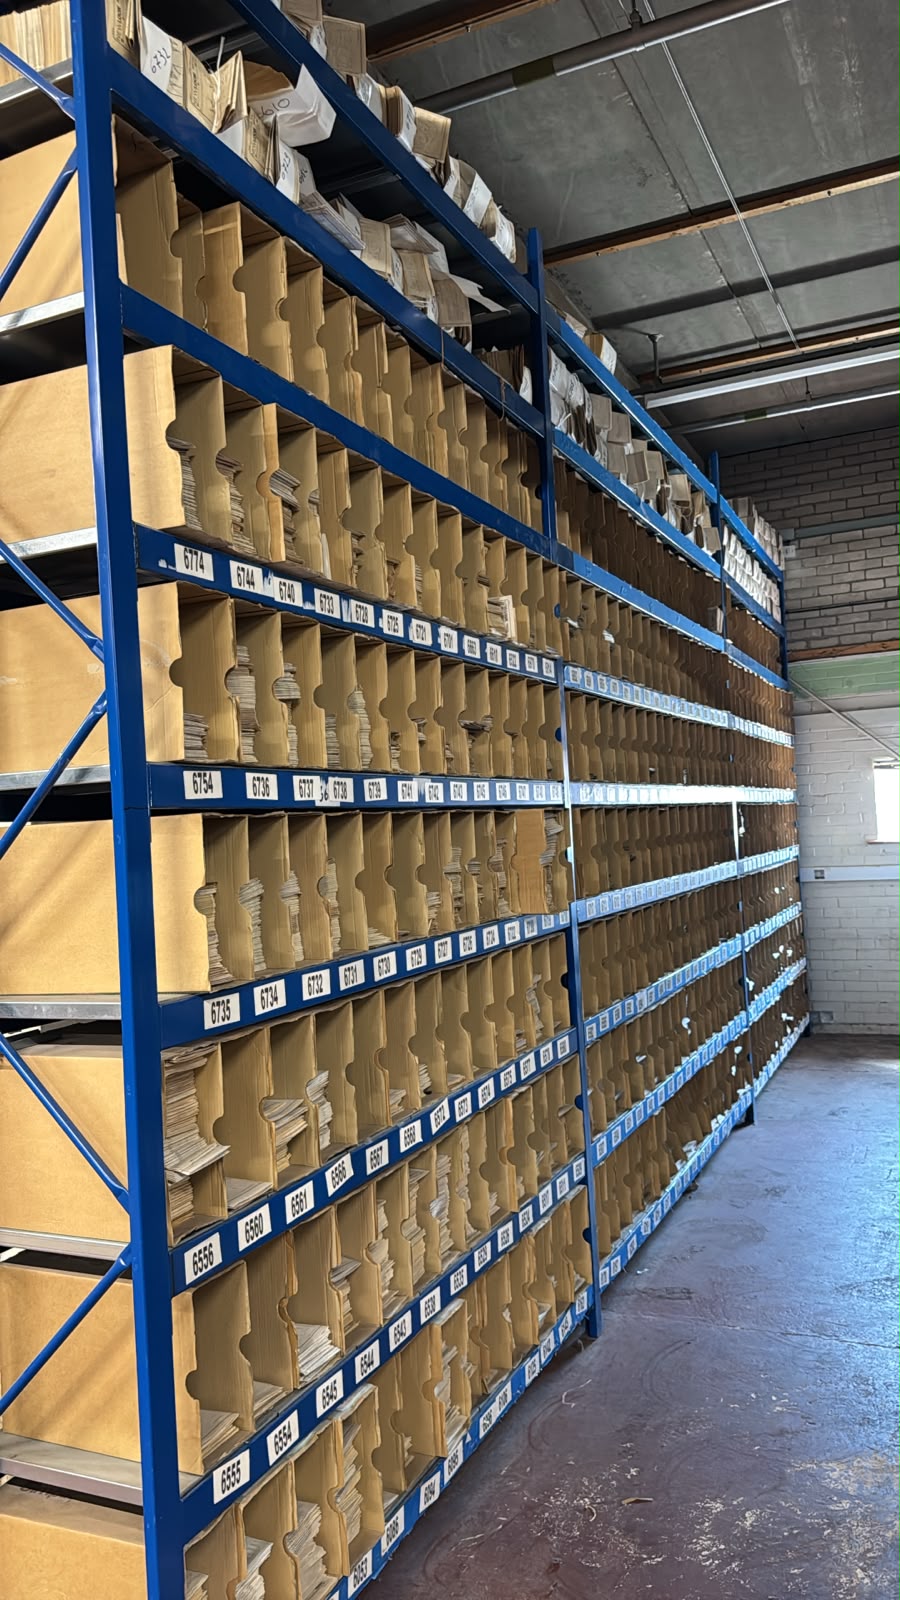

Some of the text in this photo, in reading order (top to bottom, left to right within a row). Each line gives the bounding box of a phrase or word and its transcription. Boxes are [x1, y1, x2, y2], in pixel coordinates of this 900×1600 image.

[183, 547, 204, 573] 6774
[236, 566, 255, 590] 6744
[279, 582, 296, 604] 6740
[320, 593, 334, 614] 6733
[387, 614, 399, 633] 6725
[416, 624, 426, 641] 6721
[192, 772, 213, 794] 6754
[252, 776, 270, 797] 6736
[299, 779, 314, 798] 6737
[333, 781, 347, 800] 6738
[368, 781, 381, 799] 6739
[402, 783, 412, 799] 6741
[428, 784, 439, 800] 6742
[411, 948, 422, 967] 6729
[438, 941, 448, 959] 6727
[344, 965, 358, 986] 6731
[378, 957, 390, 977] 6730
[308, 974, 323, 996] 6732
[261, 984, 278, 1010] 6734
[211, 999, 231, 1024] 6735
[434, 1103, 445, 1128] 6572
[404, 1125, 415, 1148] 6568
[370, 1146, 383, 1170] 6567
[331, 1160, 346, 1189] 6566
[291, 1189, 307, 1217] 6561
[245, 1213, 263, 1243] 6560
[193, 1242, 213, 1276] 6556
[394, 1319, 406, 1345] 6543
[360, 1350, 374, 1376] 6544
[322, 1379, 338, 1409] 6545
[274, 1421, 292, 1455] 6554
[221, 1459, 241, 1494] 6555
